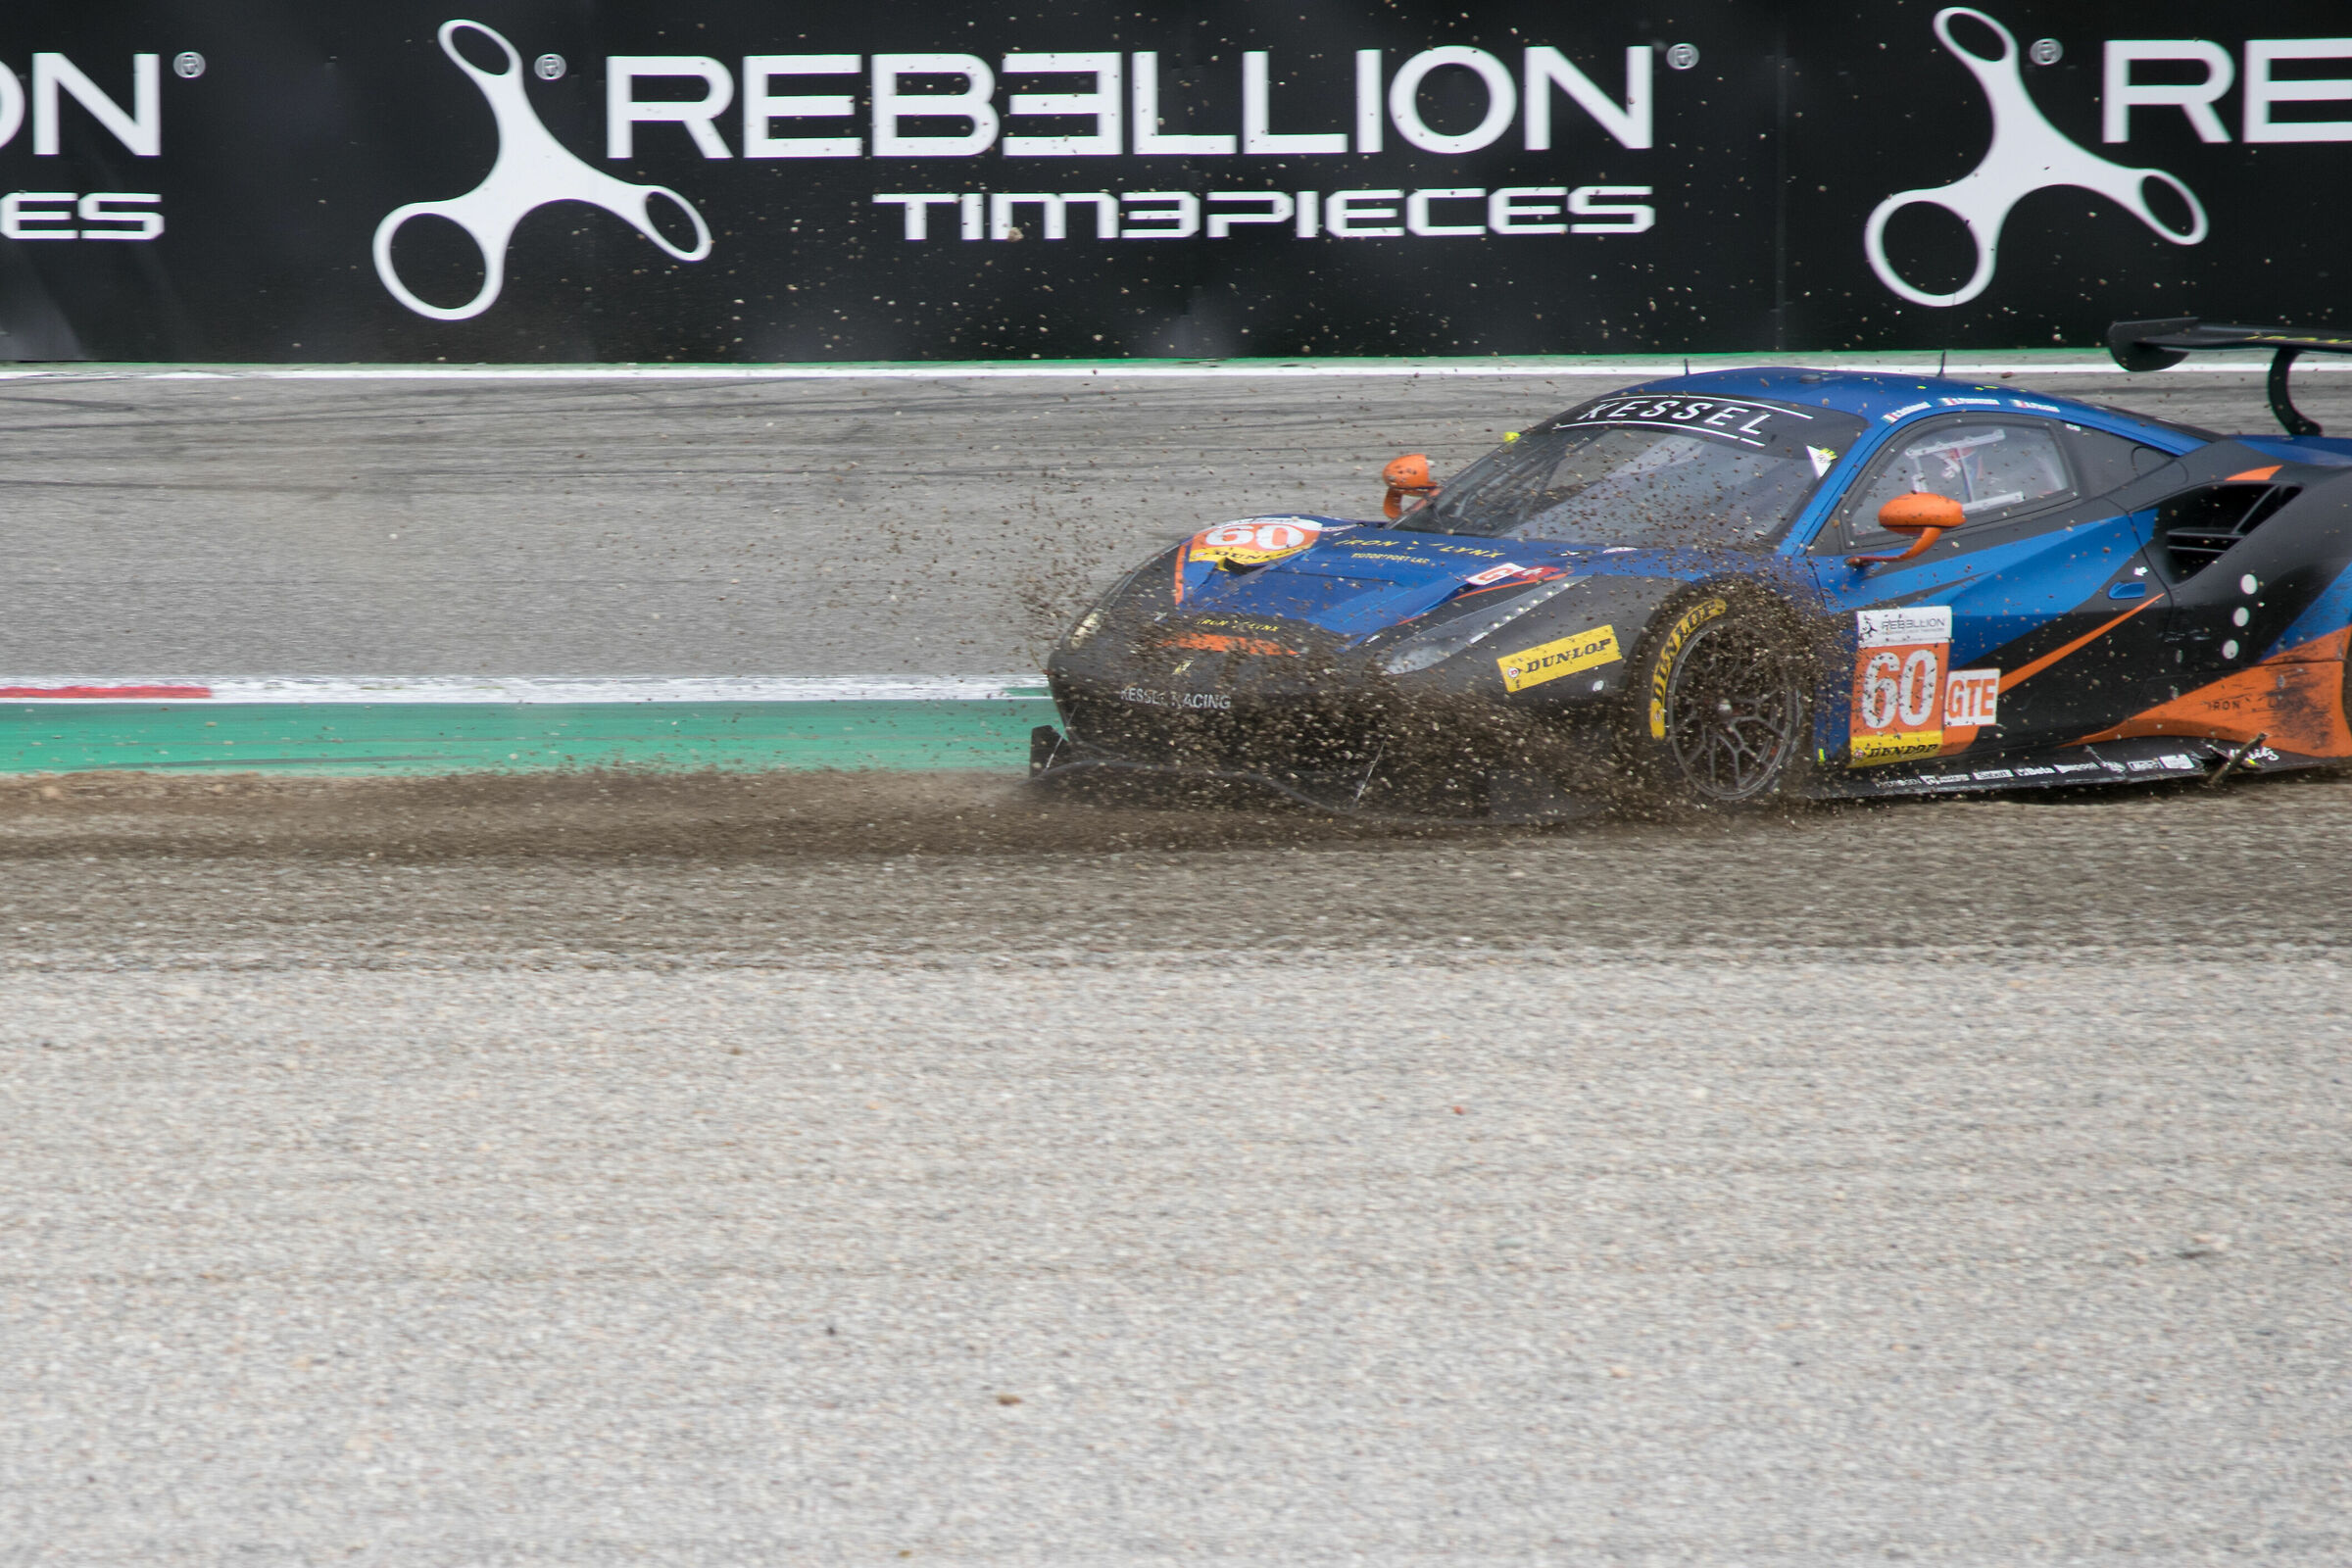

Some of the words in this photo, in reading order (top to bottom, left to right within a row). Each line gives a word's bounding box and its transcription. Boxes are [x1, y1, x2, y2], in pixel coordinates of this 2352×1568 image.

[0, 52, 161, 157] N
[607, 45, 1653, 159] REBELLION
[1576, 400, 1772, 436] KESSEL
[1205, 523, 1305, 551] 60
[1335, 539, 1400, 548] IRON
[1439, 545, 1506, 559] LYNX
[1881, 617, 1945, 631] REBELLION
[1525, 637, 1612, 674] DUNLOP
[1652, 600, 1719, 702] DUNLOP
[1862, 649, 1938, 729] 60
[1945, 677, 1997, 719] GTE
[2207, 701, 2240, 711] IRON
